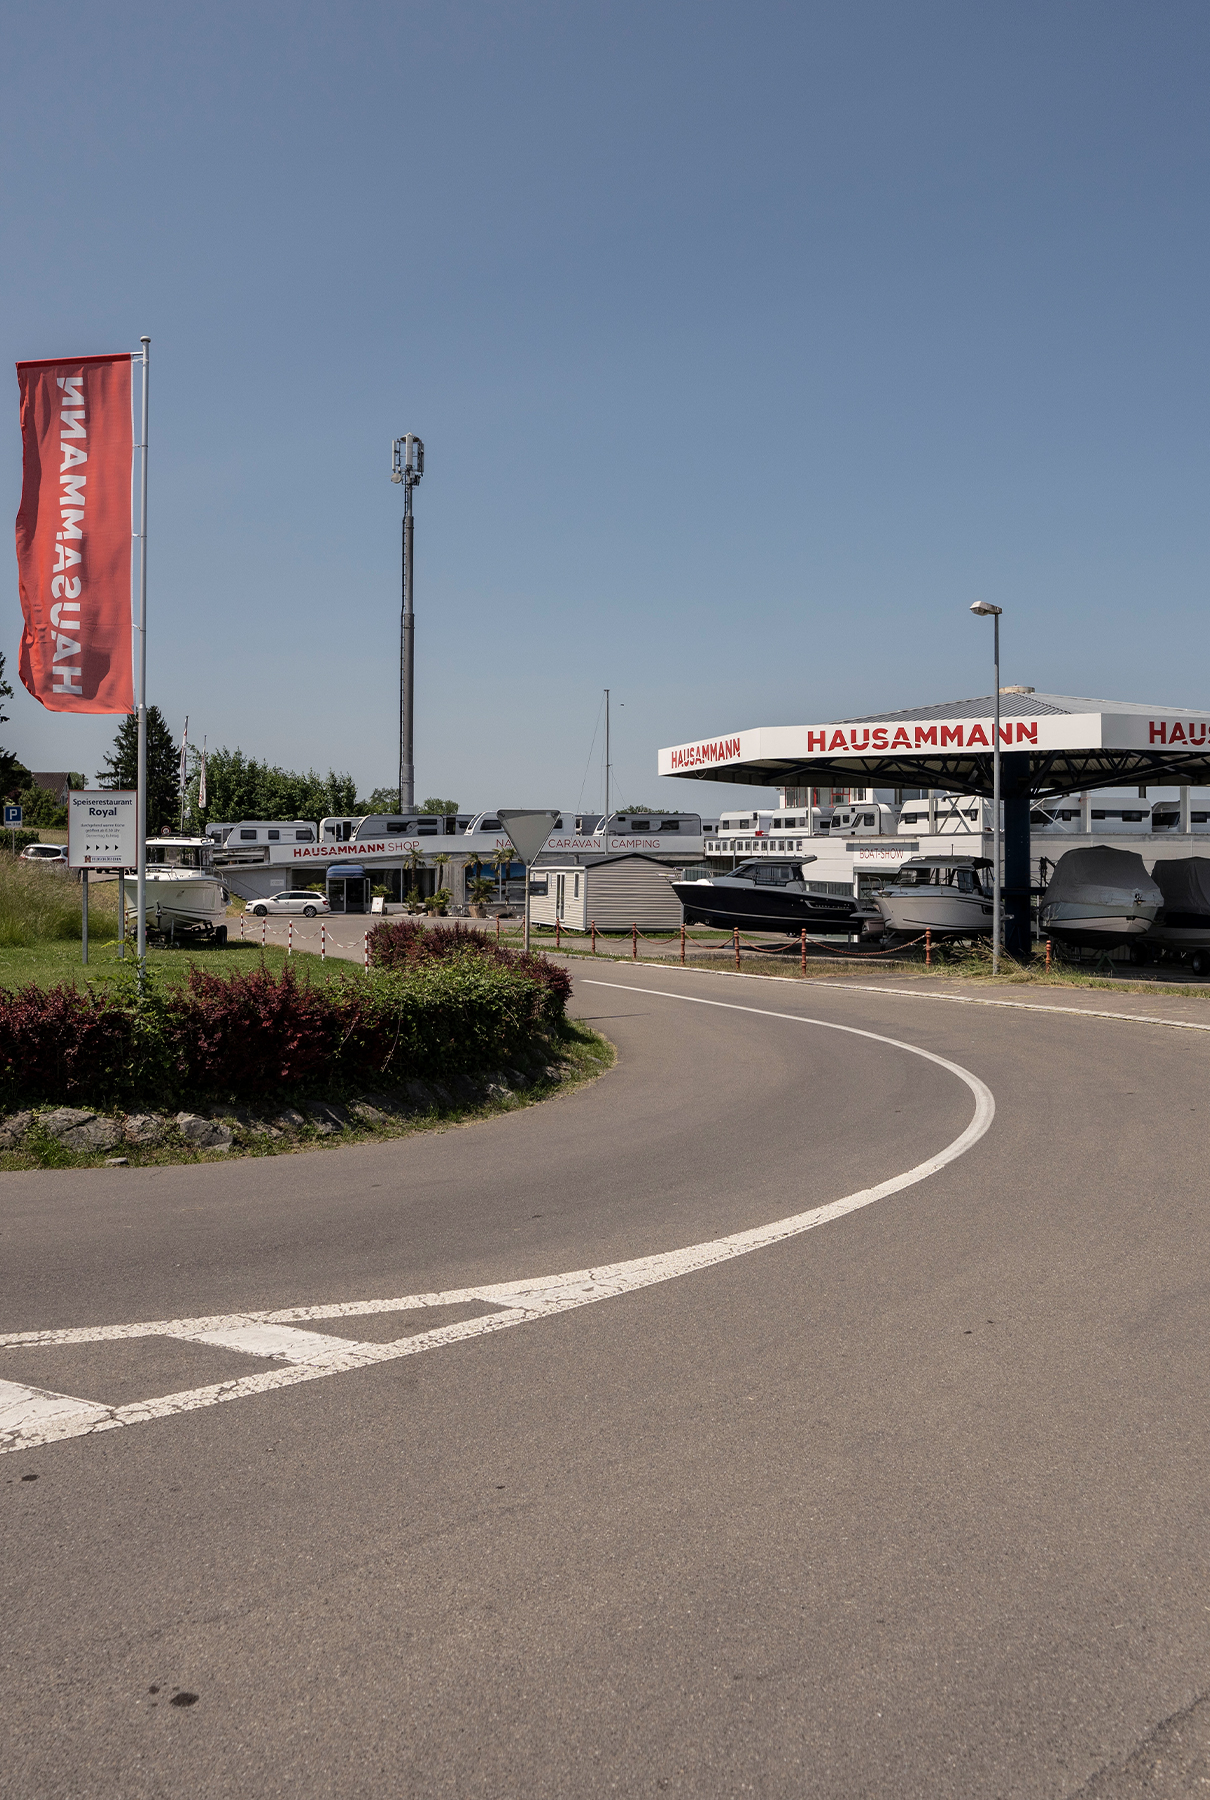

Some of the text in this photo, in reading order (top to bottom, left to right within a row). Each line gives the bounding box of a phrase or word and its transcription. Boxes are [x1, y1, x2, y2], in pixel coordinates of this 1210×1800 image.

[807, 722, 1038, 752] HAUSAMMANN
[1149, 721, 1210, 746] HAU
[671, 738, 741, 769] HAUSAMMANN
[72, 798, 132, 807] Speiserestaurant
[89, 807, 117, 818] Royal
[293, 841, 420, 858] HAUSAMMANN SHOP
[548, 839, 601, 849] CARAVAN
[611, 839, 661, 849] CAMPING
[859, 847, 905, 860] BOAT-SHOW
